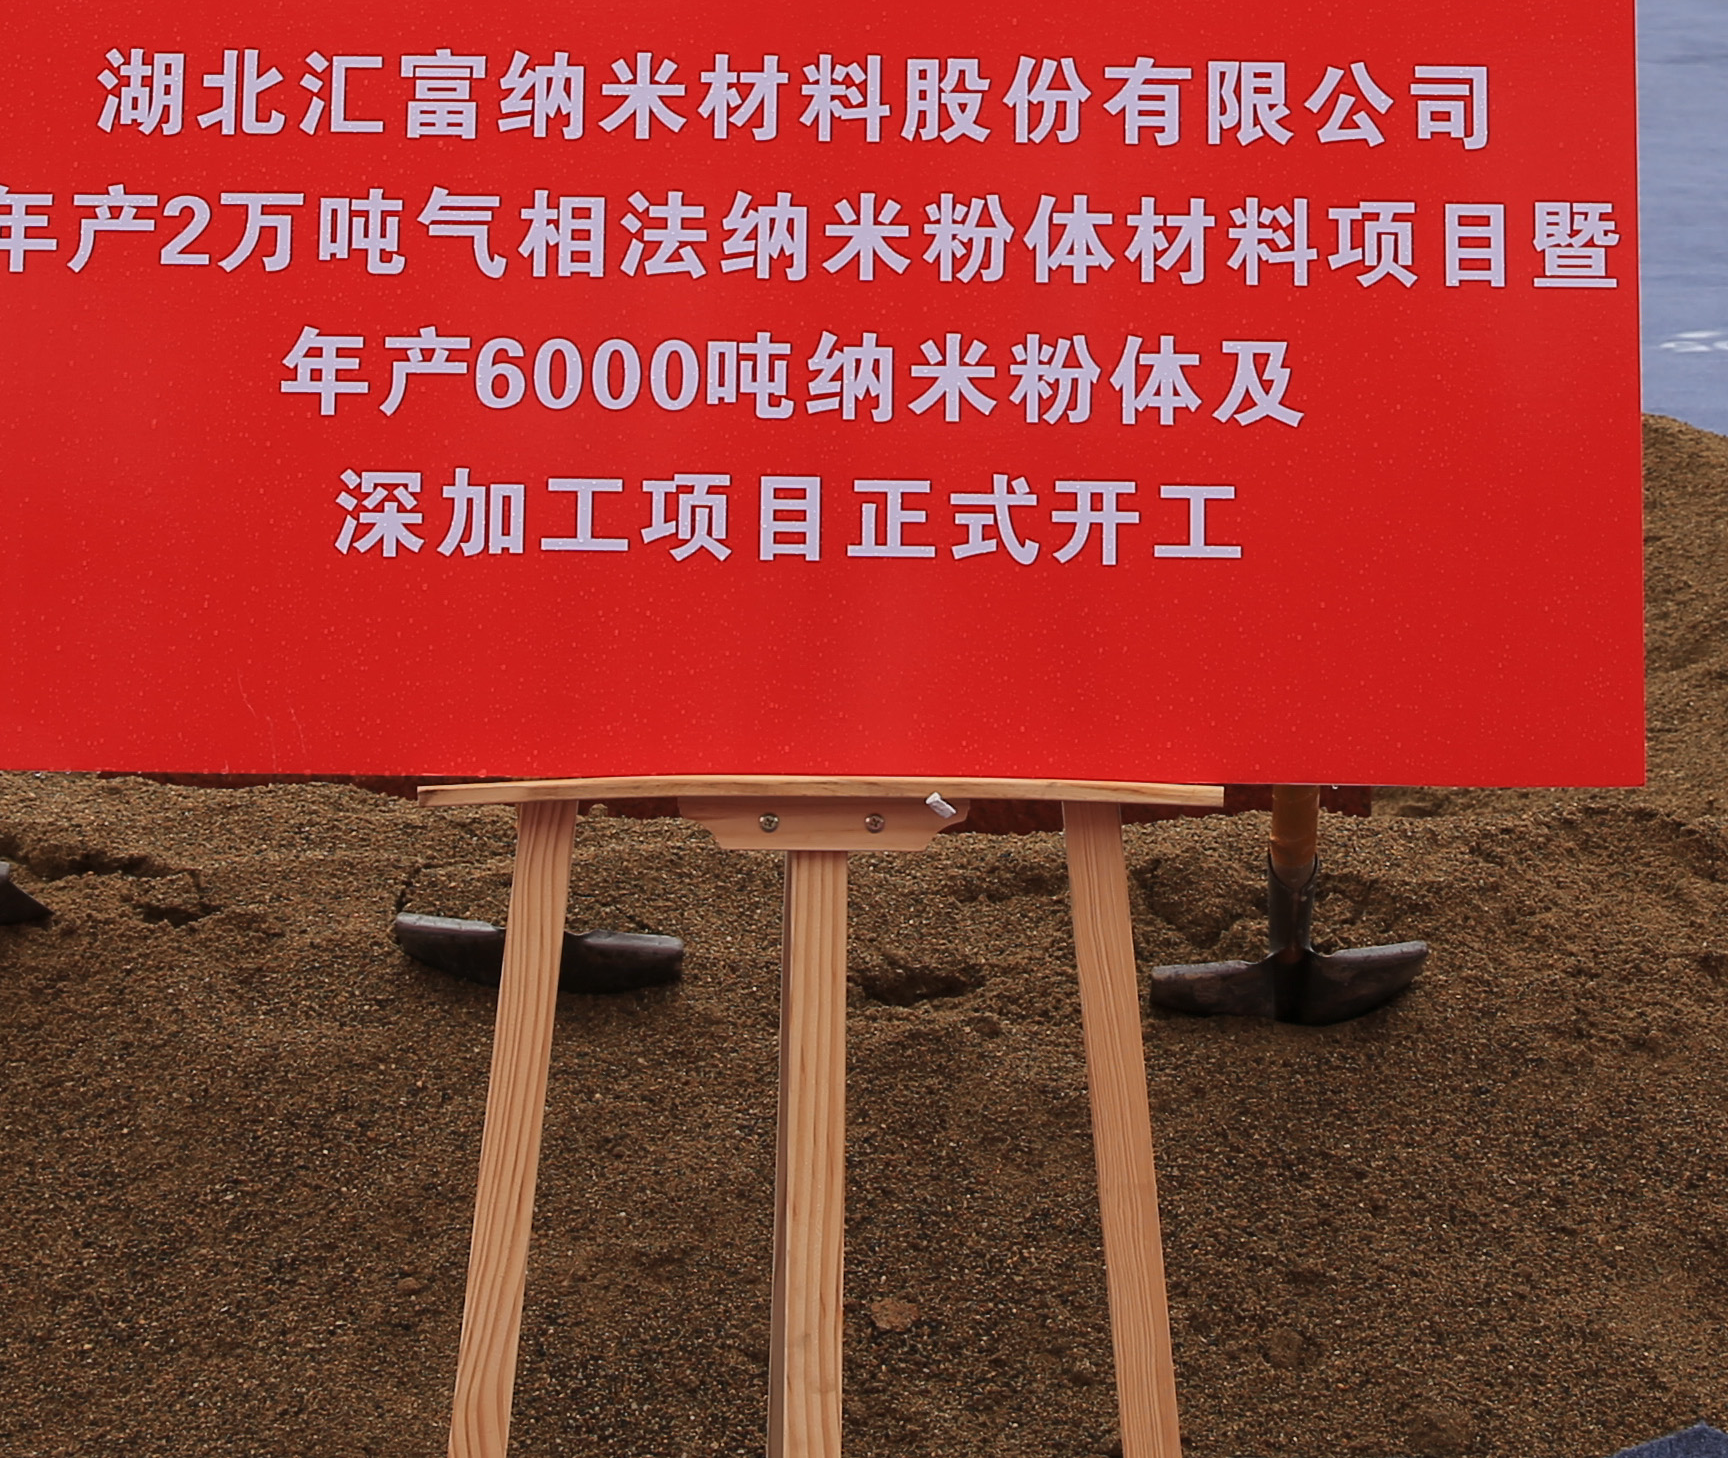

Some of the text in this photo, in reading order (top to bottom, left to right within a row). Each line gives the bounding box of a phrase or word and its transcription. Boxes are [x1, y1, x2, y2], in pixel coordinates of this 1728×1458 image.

[97, 48, 1489, 150] 湖北汇富纳米材料股份有限公司
[280, 326, 1304, 427] 年产6000吨纳米粉体及
[335, 467, 1242, 566] 深加工项目正式开工
